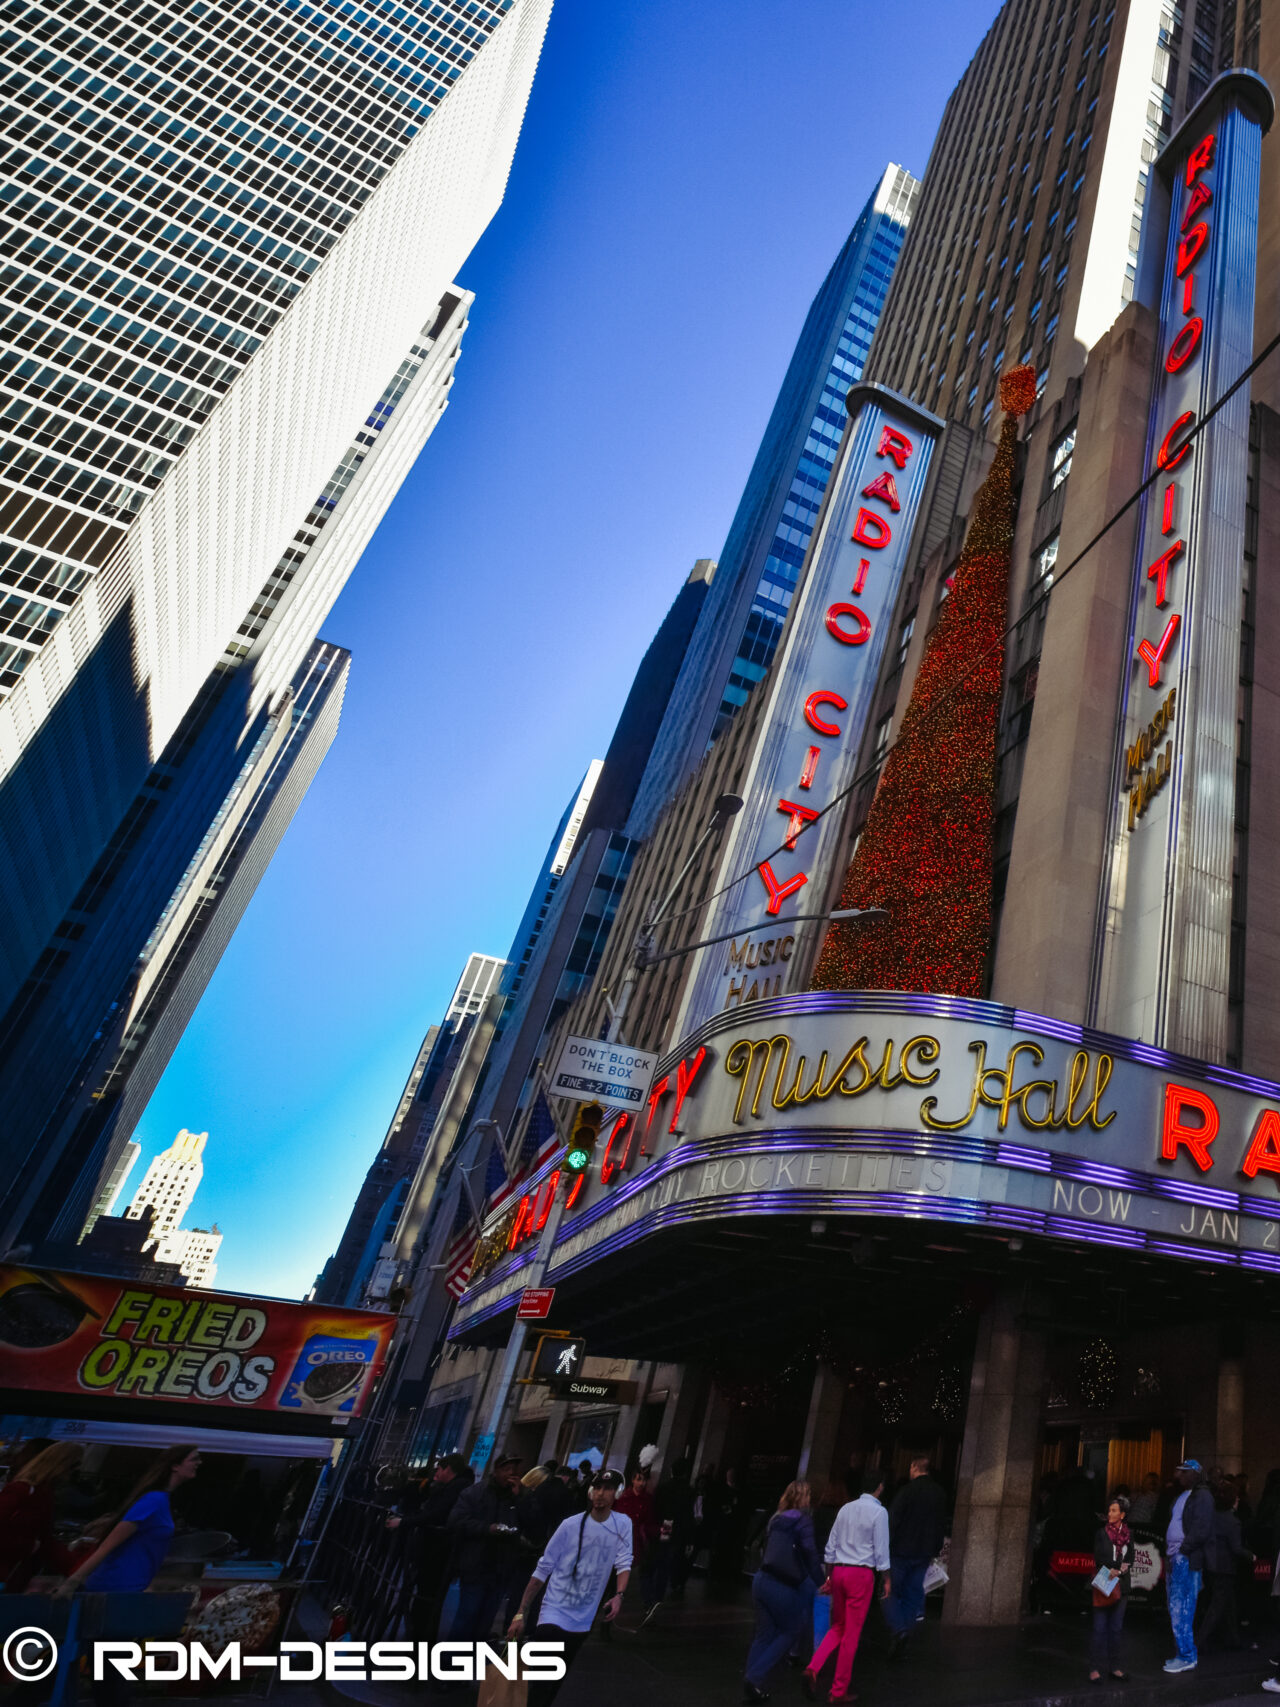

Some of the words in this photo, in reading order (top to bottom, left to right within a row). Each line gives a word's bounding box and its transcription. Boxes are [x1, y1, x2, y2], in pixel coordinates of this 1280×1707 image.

[1165, 134, 1216, 375] RADIO
[825, 425, 913, 646] RADIO
[1137, 410, 1197, 689] CITY
[757, 690, 849, 916] CITY
[560, 1075, 584, 1089] FINE
[604, 1085, 640, 1100] POINTS
[569, 1044, 607, 1060] DON'T
[609, 1053, 650, 1070] BLOCK
[581, 1059, 605, 1073] THE
[608, 1065, 633, 1079] BOX
[700, 1154, 946, 1195] ROCKETTES
[1052, 1179, 1132, 1222] NOW
[1180, 1206, 1239, 1242] JAN
[1262, 1221, 1277, 1249] 2
[100, 1289, 268, 1353] FRIED
[77, 1339, 276, 1404] OREOS
[306, 1350, 366, 1365] OREO
[570, 1383, 608, 1396] Subway
